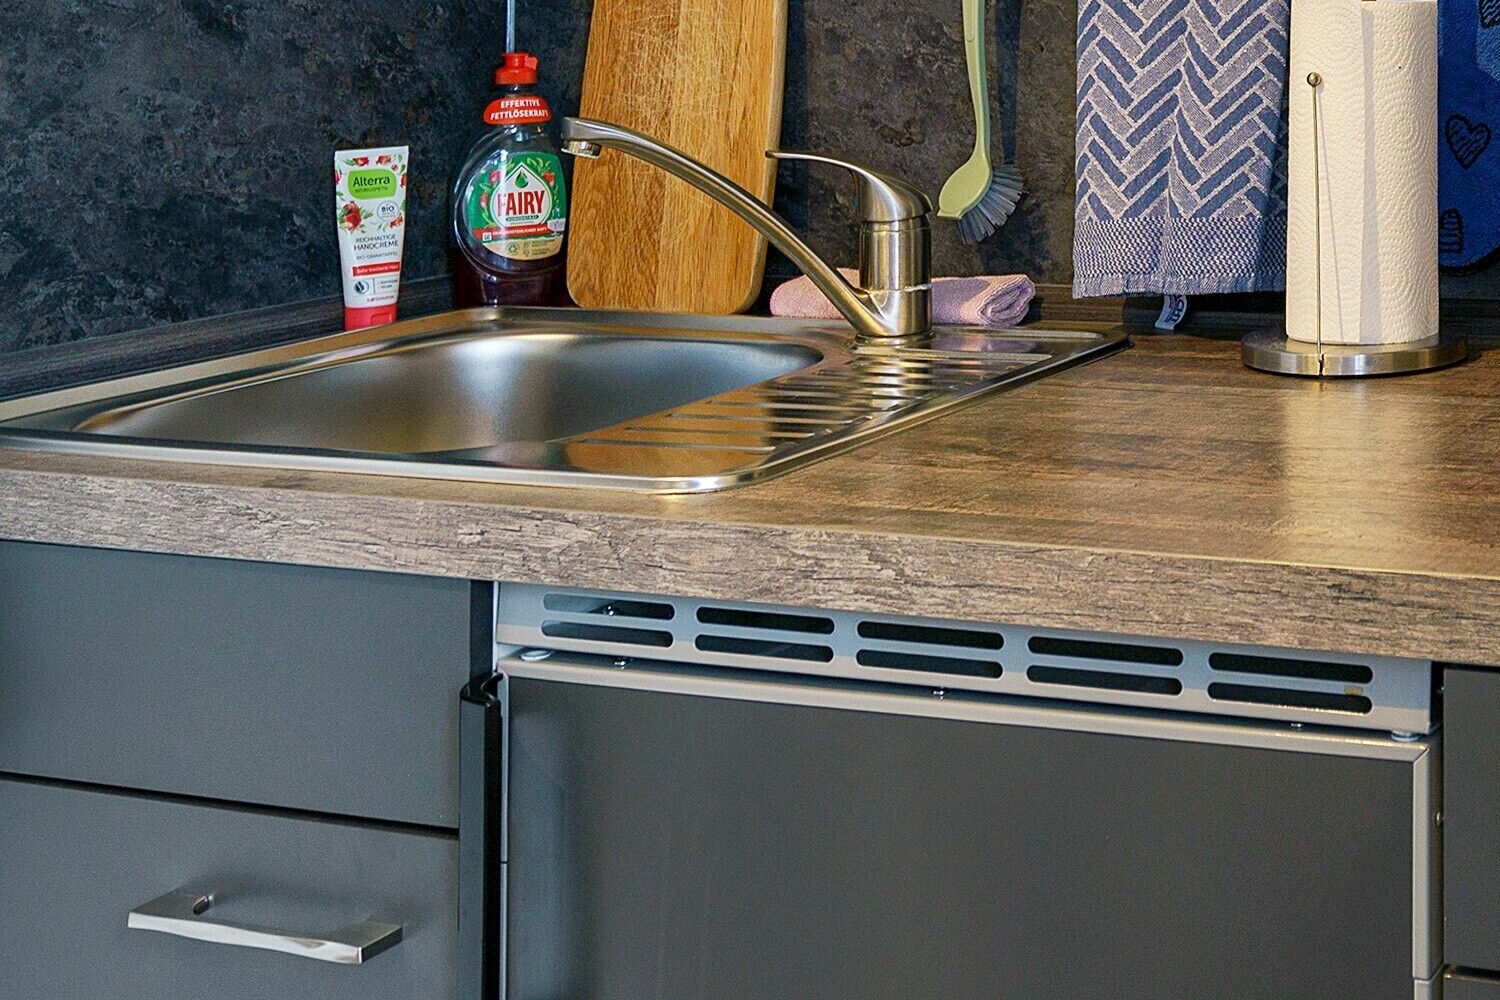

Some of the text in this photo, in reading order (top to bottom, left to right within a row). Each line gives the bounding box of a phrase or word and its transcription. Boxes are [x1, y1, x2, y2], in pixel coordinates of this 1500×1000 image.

[501, 100, 540, 108] EFFEKTIVE
[490, 109, 549, 120] FETTLÖSEKRAFT
[352, 176, 391, 187] Alterra
[497, 190, 545, 217] FAIRY
[354, 240, 399, 250] HANDCREME
